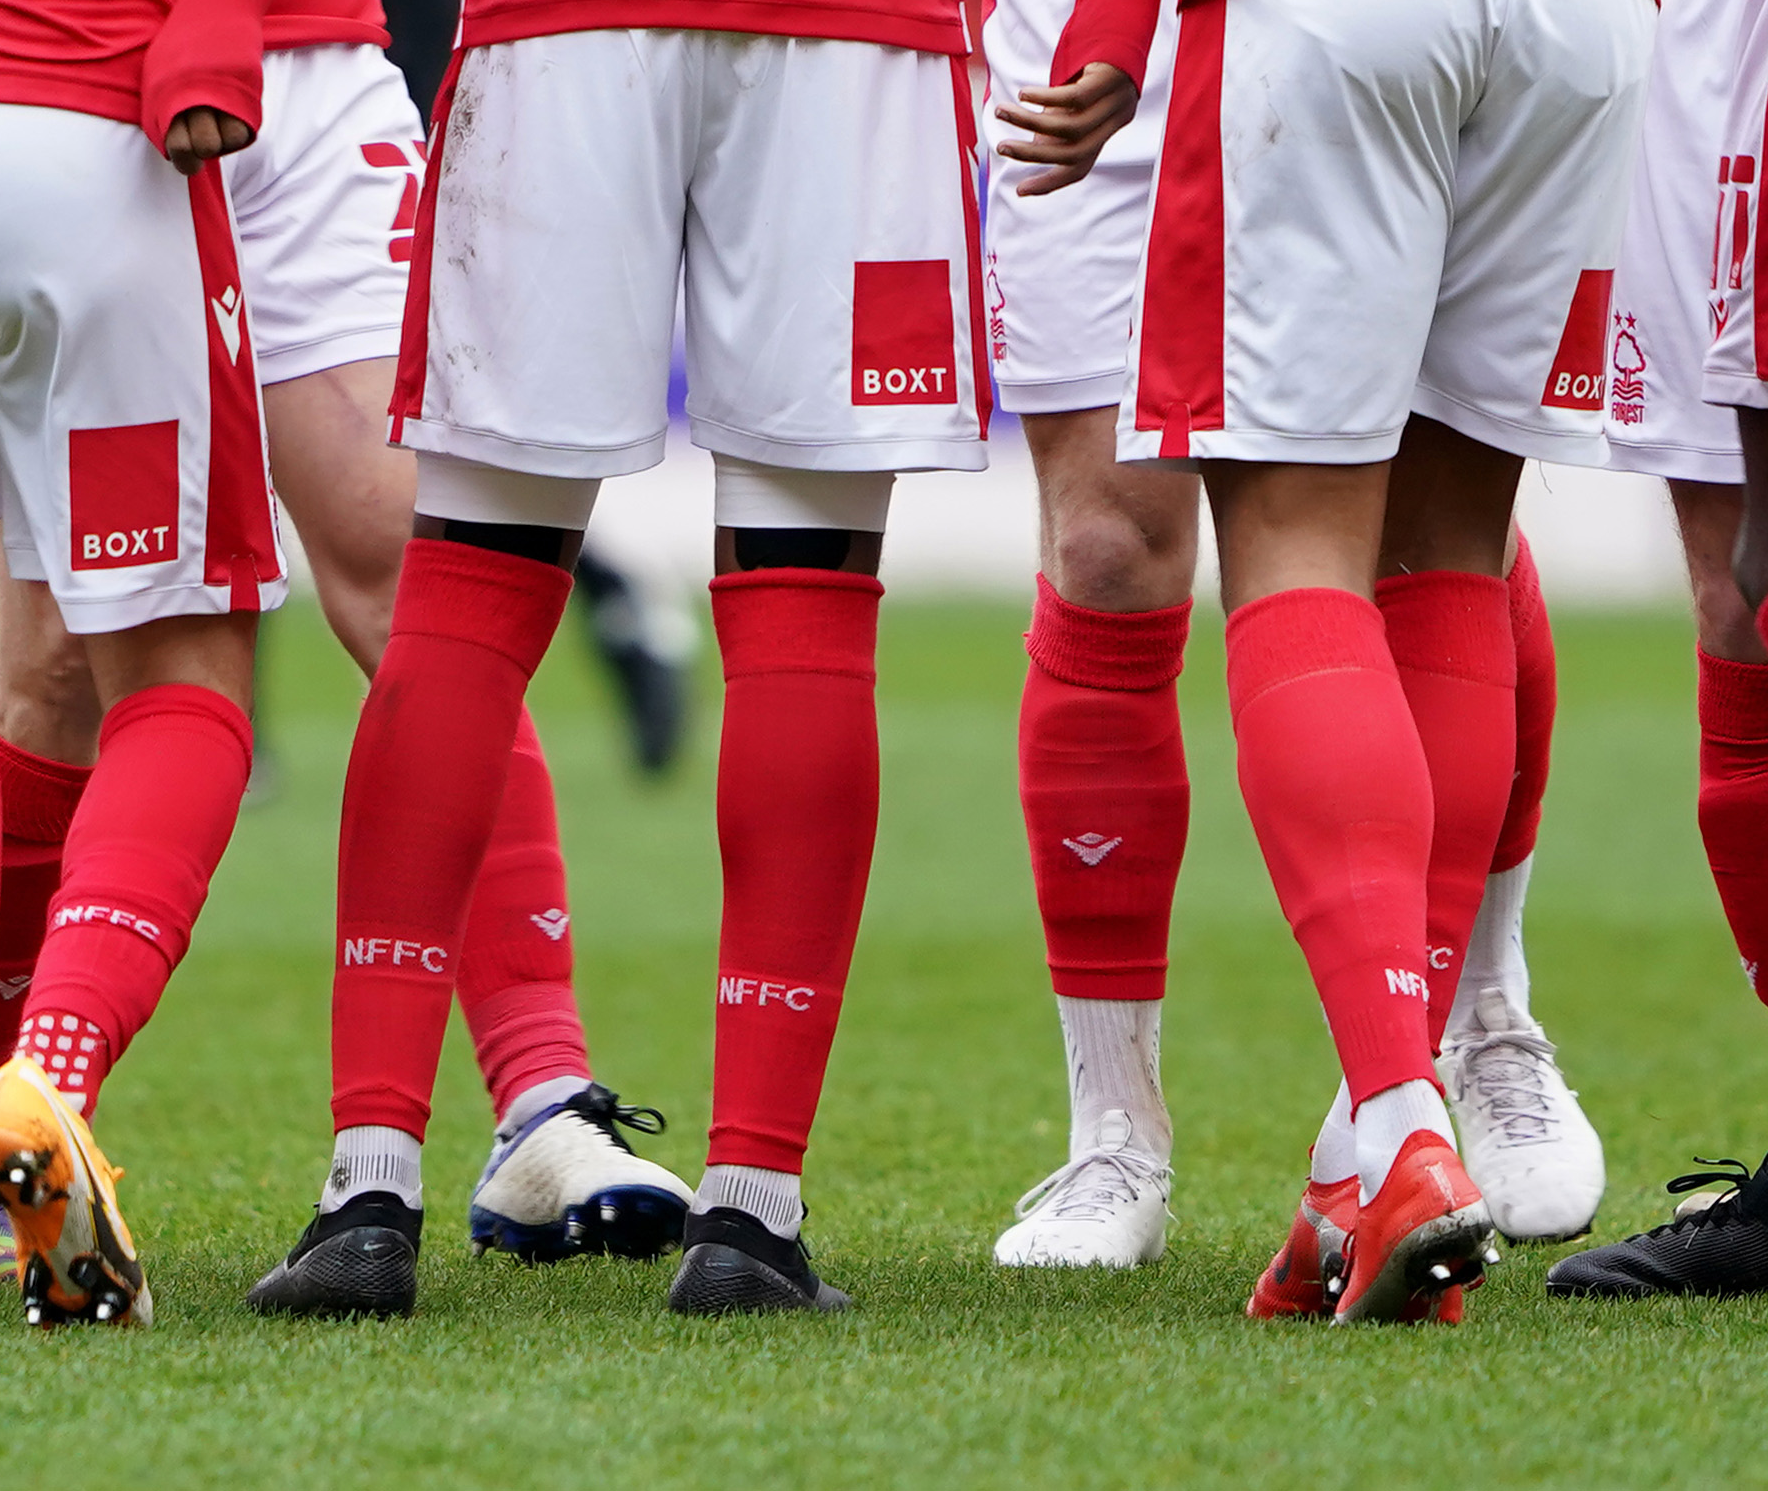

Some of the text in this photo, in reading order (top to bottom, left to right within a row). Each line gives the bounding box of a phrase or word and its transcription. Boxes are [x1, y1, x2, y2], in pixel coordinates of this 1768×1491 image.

[863, 367, 947, 395] BOXT
[1554, 372, 1605, 400] BOX
[83, 525, 169, 560] BOXT
[55, 905, 161, 941] NFFC
[344, 937, 448, 973] NFFC
[719, 976, 815, 1011] NFFC
